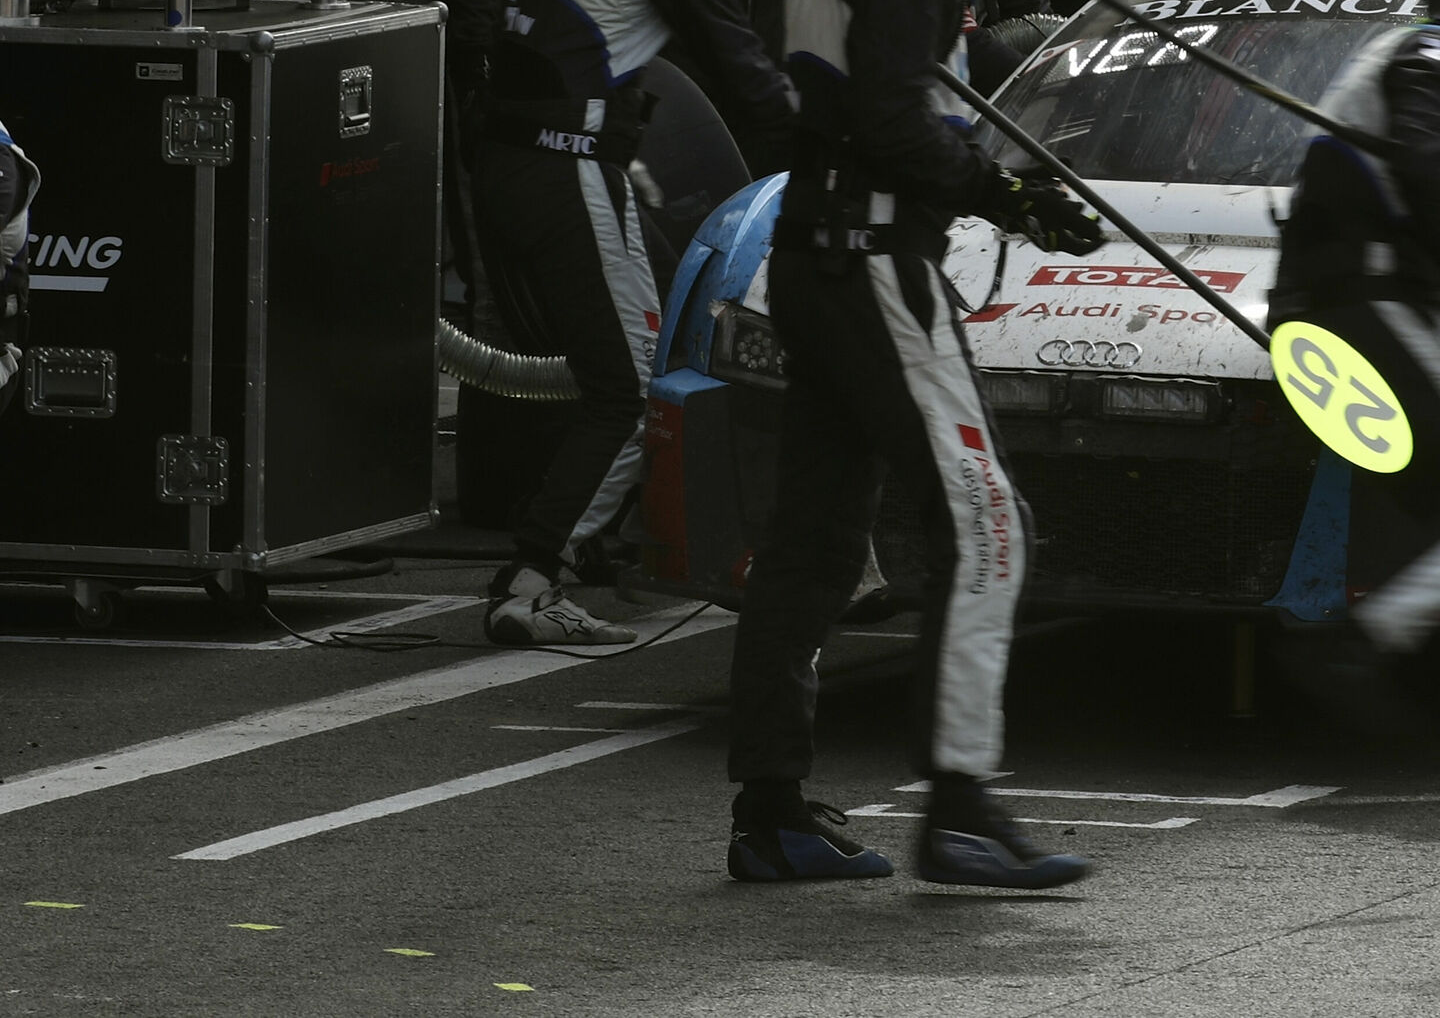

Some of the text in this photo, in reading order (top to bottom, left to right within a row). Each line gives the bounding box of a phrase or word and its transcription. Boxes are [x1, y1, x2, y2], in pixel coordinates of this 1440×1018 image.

[1020, 302, 1122, 320] Audi
[1047, 267, 1228, 291] TOTAL
[1287, 337, 1397, 455] 25
[973, 456, 1012, 582] Audi Sport
